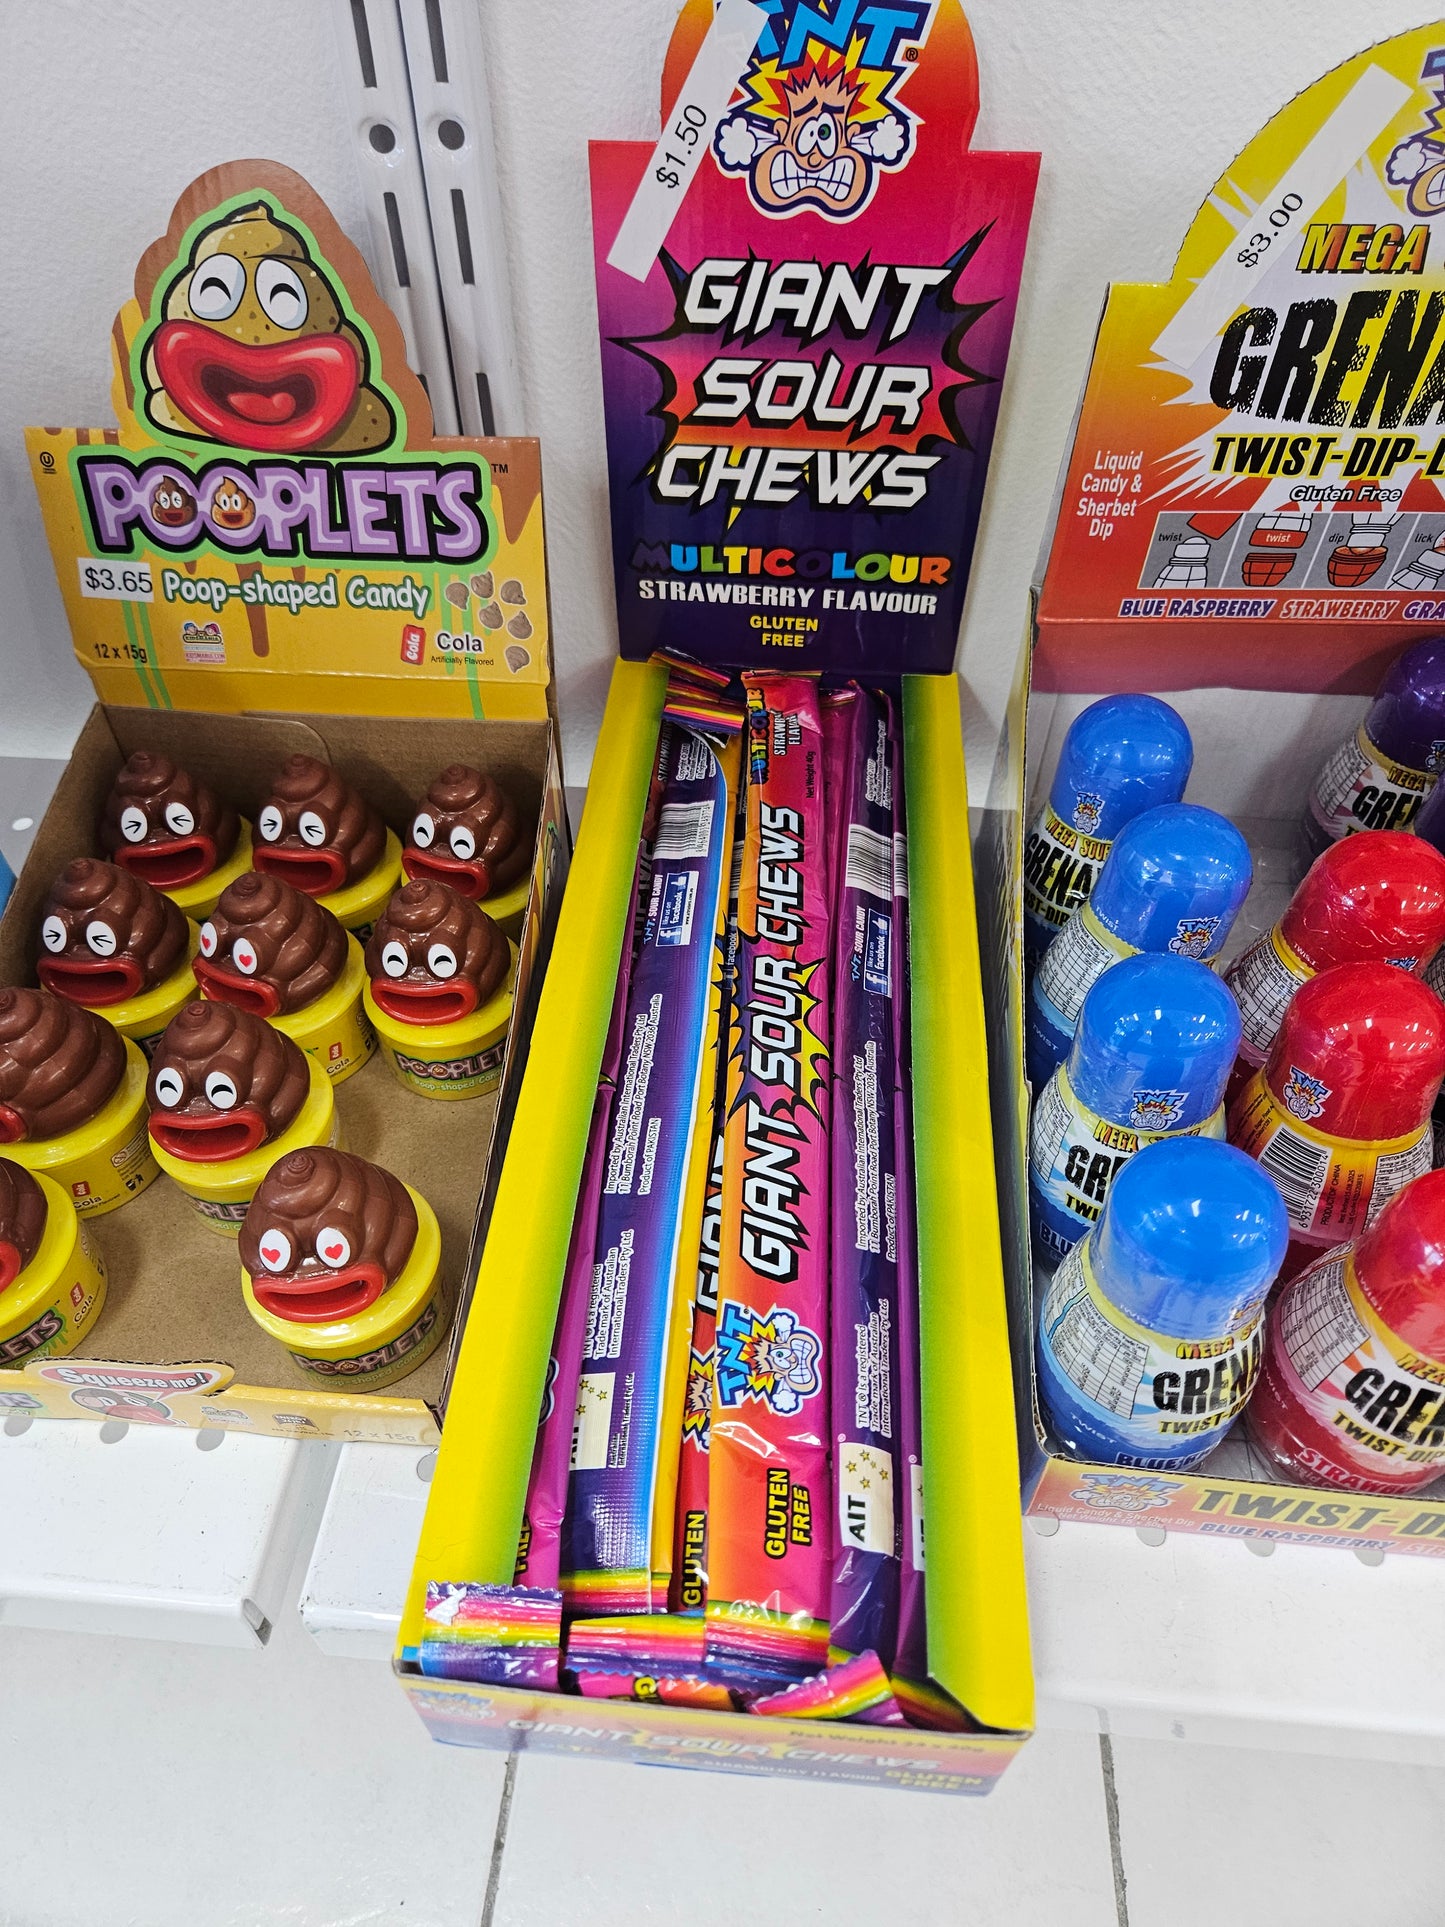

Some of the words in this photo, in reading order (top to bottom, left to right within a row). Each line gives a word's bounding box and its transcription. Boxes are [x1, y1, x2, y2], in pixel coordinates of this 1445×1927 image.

[656, 104, 707, 189] $1.50
[1236, 192, 1304, 269] $3.00
[1297, 223, 1430, 275] MEGA
[683, 257, 953, 341] GIANT
[692, 352, 933, 432] SOUR
[1094, 450, 1143, 473] Liquid
[656, 443, 943, 509] CHEWS
[1081, 473, 1128, 497] Candy
[1130, 474, 1142, 493] &
[1076, 497, 1138, 518] Sherbet
[1290, 486, 1354, 502] Gluten
[1357, 487, 1402, 502] Free
[82, 458, 485, 562] POOPLETS
[1088, 518, 1114, 541] Dip
[1158, 532, 1183, 542] twist
[1265, 533, 1291, 543] twist
[1328, 532, 1345, 545] dip
[1414, 533, 1434, 543] lick
[629, 537, 954, 586] MULTICOLOUR
[84, 566, 153, 594] $3.65
[163, 571, 338, 614] Poop-shaped
[348, 574, 430, 618] Candy
[639, 579, 816, 609] STRAWBERRY
[822, 589, 939, 616] FLAVOUR
[1120, 599, 1166, 617] BLUE
[1167, 599, 1274, 618] RASPBERRY
[1280, 600, 1399, 619] STRAWBERRY
[749, 614, 819, 632] GLUTEN
[94, 643, 110, 659] 12
[112, 647, 121, 659] x
[123, 644, 148, 664] 15g
[436, 632, 484, 653] Cola
[761, 633, 805, 648] FREE
[430, 655, 463, 665] Artificially
[464, 657, 495, 667] Flavored
[805, 764, 816, 787] Weight
[1388, 766, 1428, 793] MEGA
[806, 786, 815, 799] Net
[1078, 792, 1102, 809] TNT
[1045, 816, 1078, 851] MEGA
[652, 874, 664, 896] CANDY
[758, 803, 803, 943] CHEWS
[648, 897, 660, 917] SOUR
[669, 891, 683, 925] facebook
[856, 904, 866, 931] CANDY
[1095, 906, 1120, 932] TWIST
[1182, 919, 1219, 934] TNT
[727, 932, 738, 966] facebook
[854, 932, 864, 954] SOUR
[874, 935, 886, 970] facebook
[649, 994, 661, 1024] Australia
[747, 955, 802, 1088] SOUR
[647, 1026, 657, 1041] 2036
[1032, 1023, 1060, 1052] TWIST
[630, 1037, 642, 1059] Traders
[643, 1041, 652, 1059] NSW
[866, 1041, 875, 1070] Australia
[326, 1058, 350, 1074] Cola
[638, 1060, 652, 1083] Botany
[622, 1060, 637, 1102] International
[635, 1085, 645, 1100] Port
[866, 1073, 876, 1091] 2036
[1291, 1067, 1329, 1098] TNT
[855, 1083, 863, 1108] Traders
[866, 1092, 875, 1110] NSW
[1134, 1091, 1184, 1107] TNT
[617, 1106, 628, 1142] Australian
[631, 1101, 642, 1120] Road
[868, 1110, 879, 1134] Botany
[628, 1122, 640, 1140] Point
[856, 1108, 865, 1153] International
[869, 1135, 878, 1150] Port
[1093, 1120, 1140, 1153] MEGA
[612, 1143, 624, 1155] by
[621, 1142, 635, 1182] Bumborah
[639, 1164, 652, 1193] Product
[646, 1118, 659, 1153] PAKISTAN
[869, 1151, 878, 1172] Road
[606, 1155, 619, 1192] Imported
[857, 1155, 867, 1194] Australian
[869, 1175, 878, 1194] Point
[1300, 1189, 1319, 1220] 931722
[1310, 1152, 1330, 1188] 300014
[741, 1098, 804, 1278] GIANT
[885, 1174, 895, 1214] PAKISTAN
[1320, 1195, 1335, 1225] PRODUCT
[1330, 1163, 1343, 1185] CHINA
[73, 1196, 102, 1209] Cola
[858, 1209, 868, 1248] Imported
[869, 1198, 879, 1240] Bumborah
[620, 1247, 632, 1262] Pty
[887, 1225, 896, 1260] Product
[604, 1248, 617, 1292] Australian
[617, 1263, 628, 1295] Traders
[590, 1264, 602, 1308] registered
[74, 1295, 94, 1323] Cola
[600, 1304, 609, 1328] mark
[290, 1303, 437, 1376] POOPLETS
[609, 1297, 624, 1357] International
[869, 1312, 879, 1359] Australian
[594, 1334, 606, 1357] Trade
[720, 1303, 752, 1404] TNT
[857, 1325, 869, 1372] registered
[880, 1334, 889, 1369] Traders
[1175, 1336, 1235, 1360] MEGA
[56, 1368, 169, 1388] Squeeze
[870, 1373, 879, 1399] mark
[881, 1370, 890, 1435] International
[870, 1405, 879, 1429] Trade
[1070, 1412, 1117, 1444] TWIST
[1116, 1452, 1180, 1470] BLUE
[1081, 1473, 1187, 1493] TNT
[766, 1469, 789, 1556] GLUTEN
[791, 1486, 811, 1543] FREE
[849, 1498, 866, 1542] AIT
[1037, 1503, 1073, 1514] Liquid
[1076, 1507, 1113, 1518] Candy
[1199, 1523, 1257, 1537] BLUE
[1262, 1529, 1395, 1550] RASPBERRY
[682, 1513, 706, 1605] GLUTEN
[507, 1719, 633, 1738] GIANT
[653, 1734, 770, 1757] SOUR
[787, 1748, 942, 1770] CHEWS
[885, 1769, 983, 1786] GLUTEN
[899, 1778, 962, 1790] FREE
